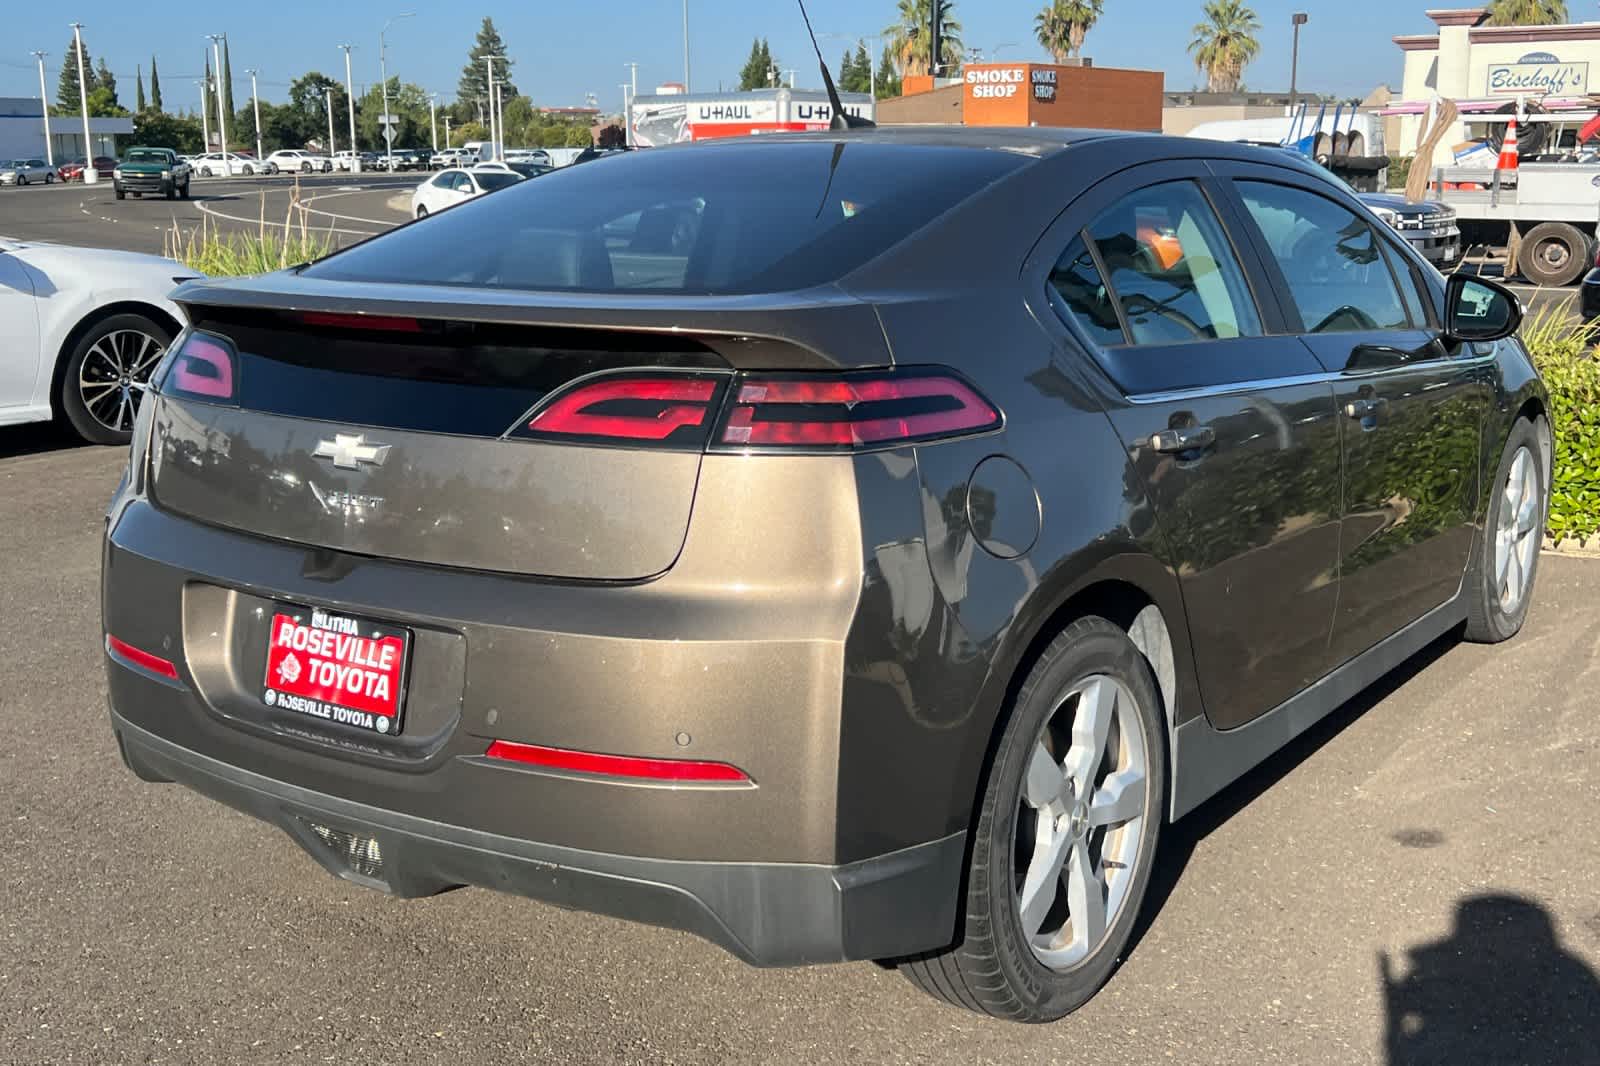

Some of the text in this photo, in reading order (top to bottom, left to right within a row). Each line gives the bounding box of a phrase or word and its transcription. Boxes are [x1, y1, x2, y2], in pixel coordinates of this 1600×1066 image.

[966, 69, 1024, 83] SMOKE
[1031, 70, 1057, 83] SMOKE
[1491, 67, 1581, 94] Bischoff's
[973, 85, 1017, 98] SHOP
[1035, 85, 1054, 98] SHOP
[700, 105, 752, 119] U-HAUL
[277, 622, 396, 671] ROSEVILLE
[308, 657, 389, 702] TOYOTA
[332, 706, 373, 728] TOYOTA
